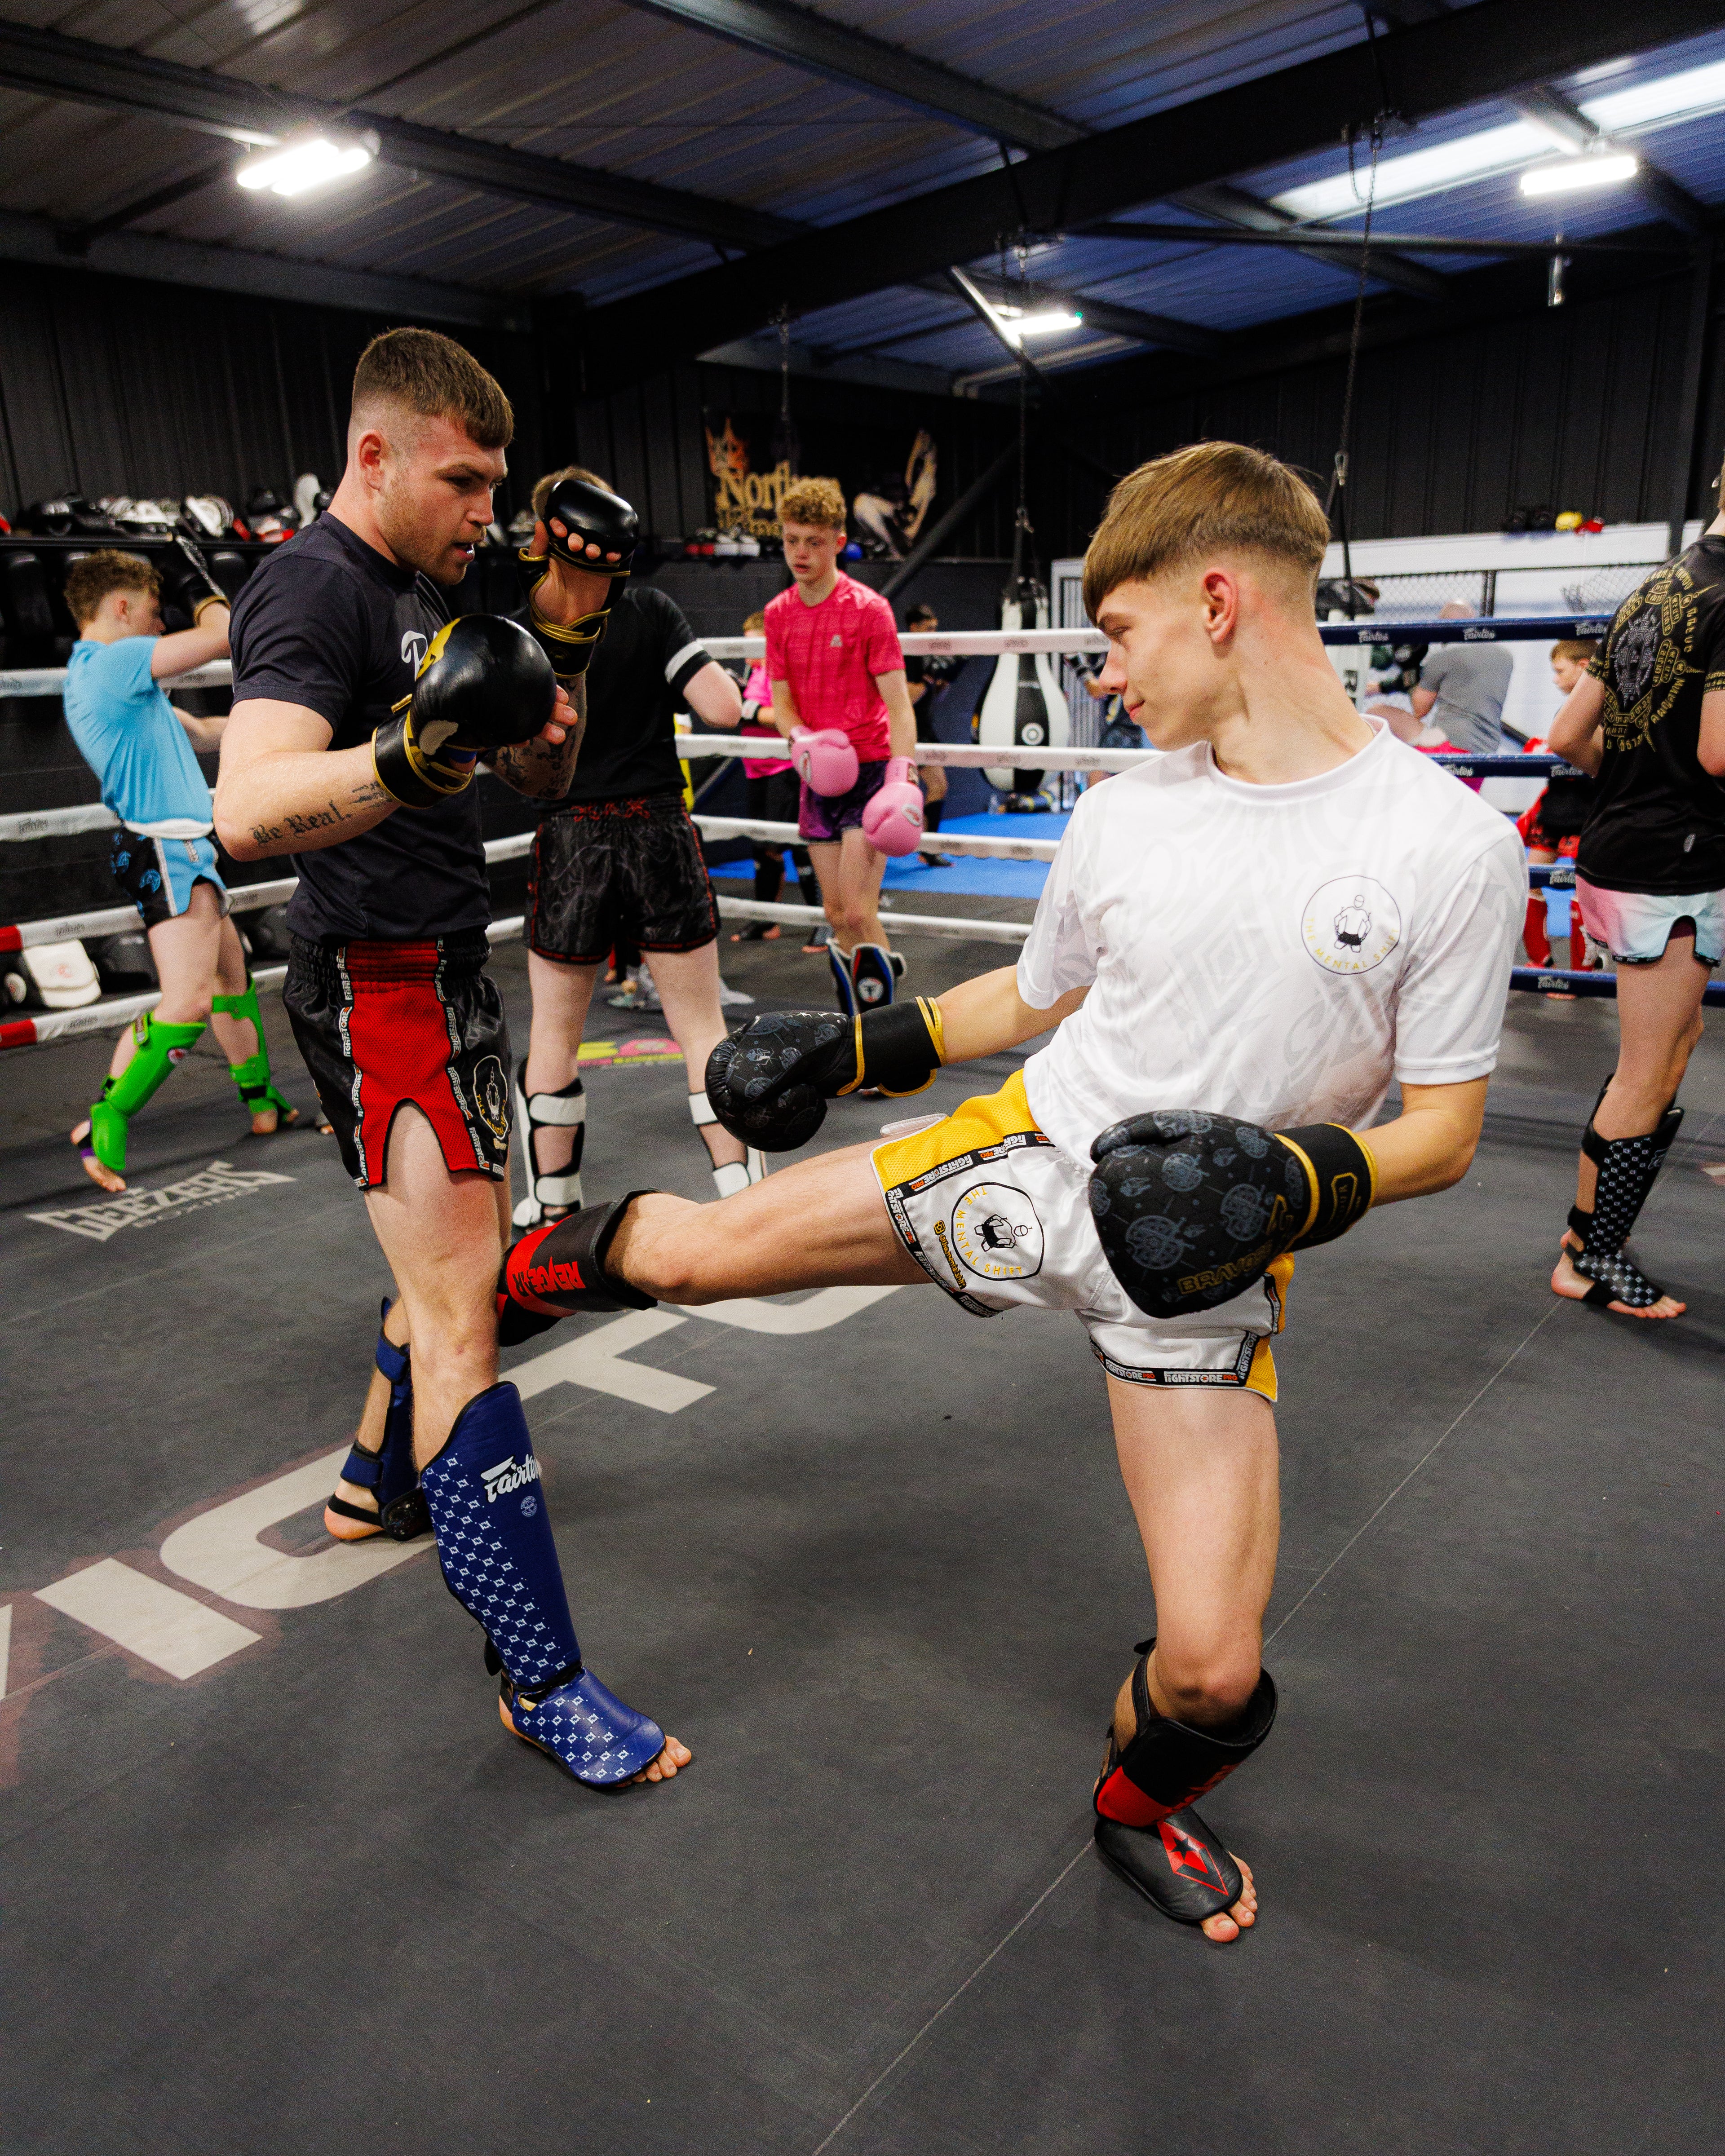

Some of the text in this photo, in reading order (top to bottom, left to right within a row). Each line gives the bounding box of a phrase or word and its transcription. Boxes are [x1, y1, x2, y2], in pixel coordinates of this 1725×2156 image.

[955, 1186, 1023, 1276] THE MENTAL SHIFT
